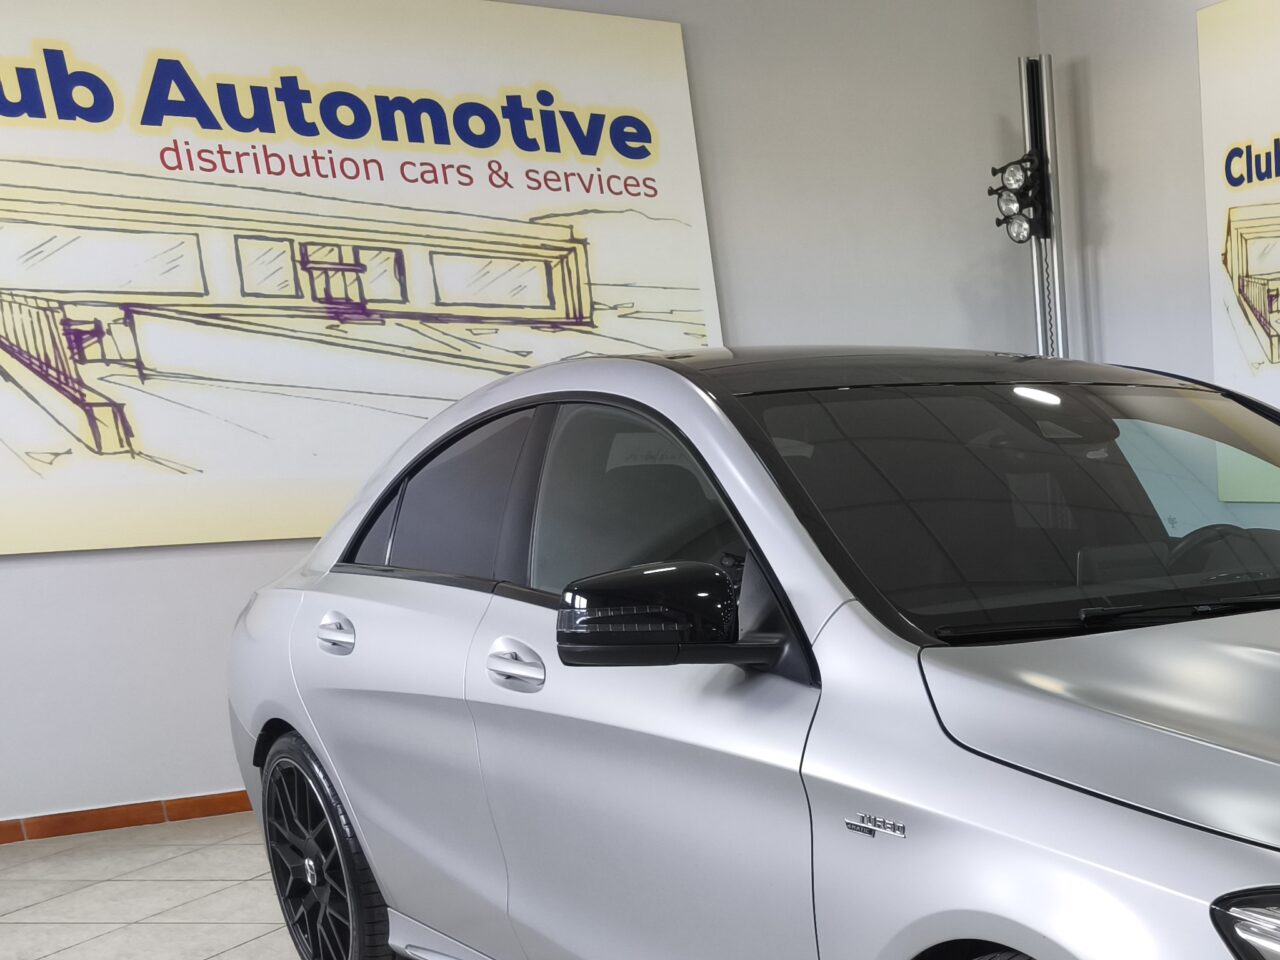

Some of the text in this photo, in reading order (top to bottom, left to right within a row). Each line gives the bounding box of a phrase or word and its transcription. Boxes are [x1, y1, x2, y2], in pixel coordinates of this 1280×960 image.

[140, 58, 652, 161] Automotive
[159, 140, 658, 198] distribution cars & services
[856, 812, 906, 835] TURBO
